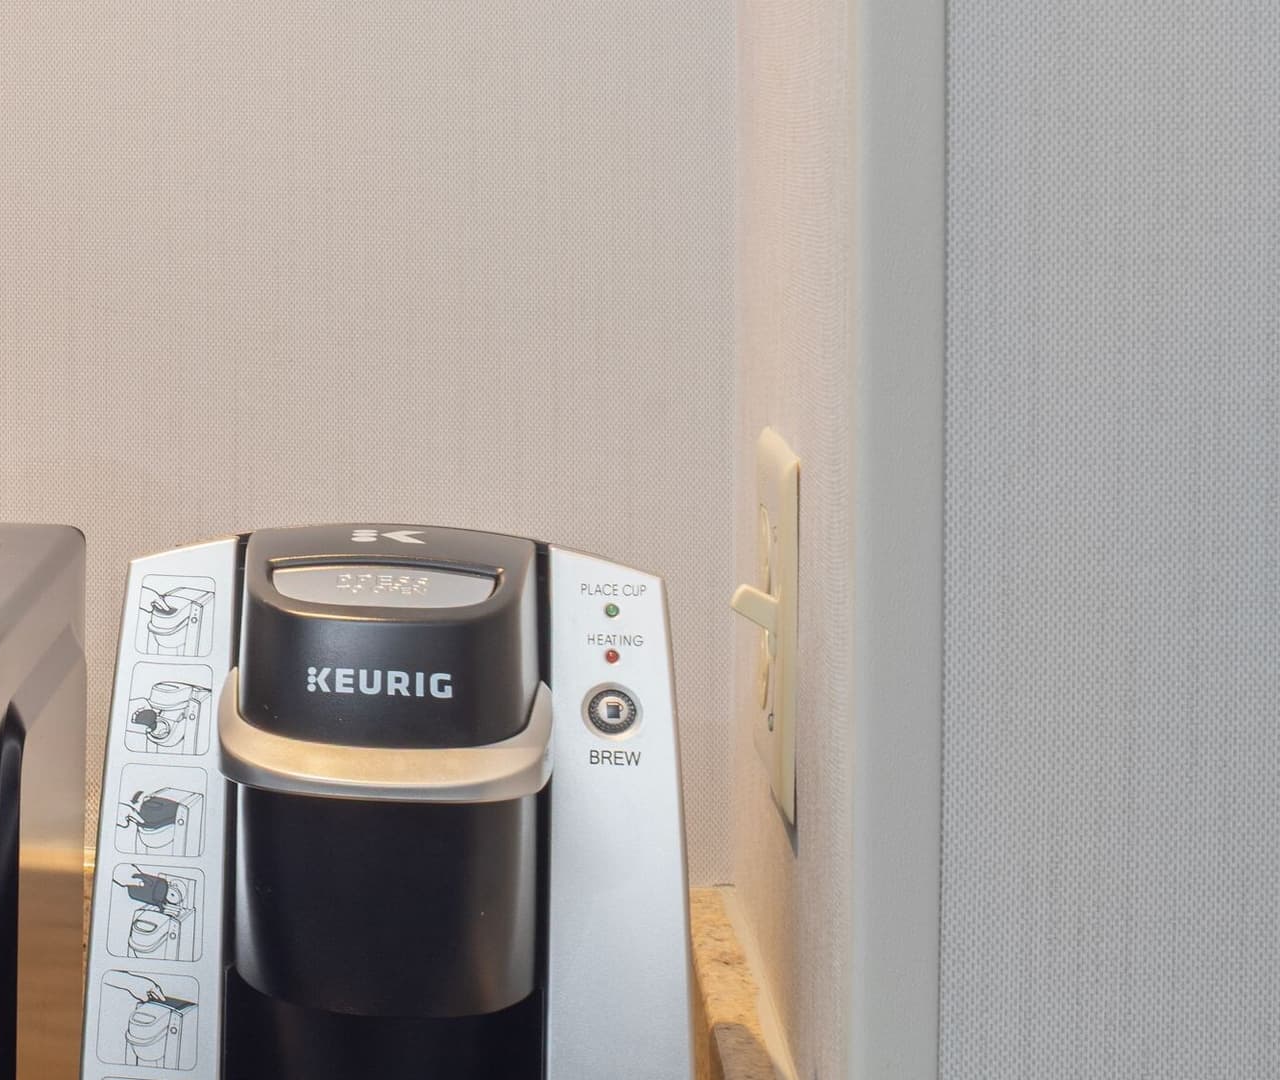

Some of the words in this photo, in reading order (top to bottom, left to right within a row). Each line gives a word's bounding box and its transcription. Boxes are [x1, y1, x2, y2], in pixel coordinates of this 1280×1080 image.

[580, 583, 618, 597] PLACE
[622, 584, 646, 597] CUP
[587, 634, 644, 647] HEATING
[307, 667, 453, 698] KEURIG
[589, 749, 641, 766] BREW
